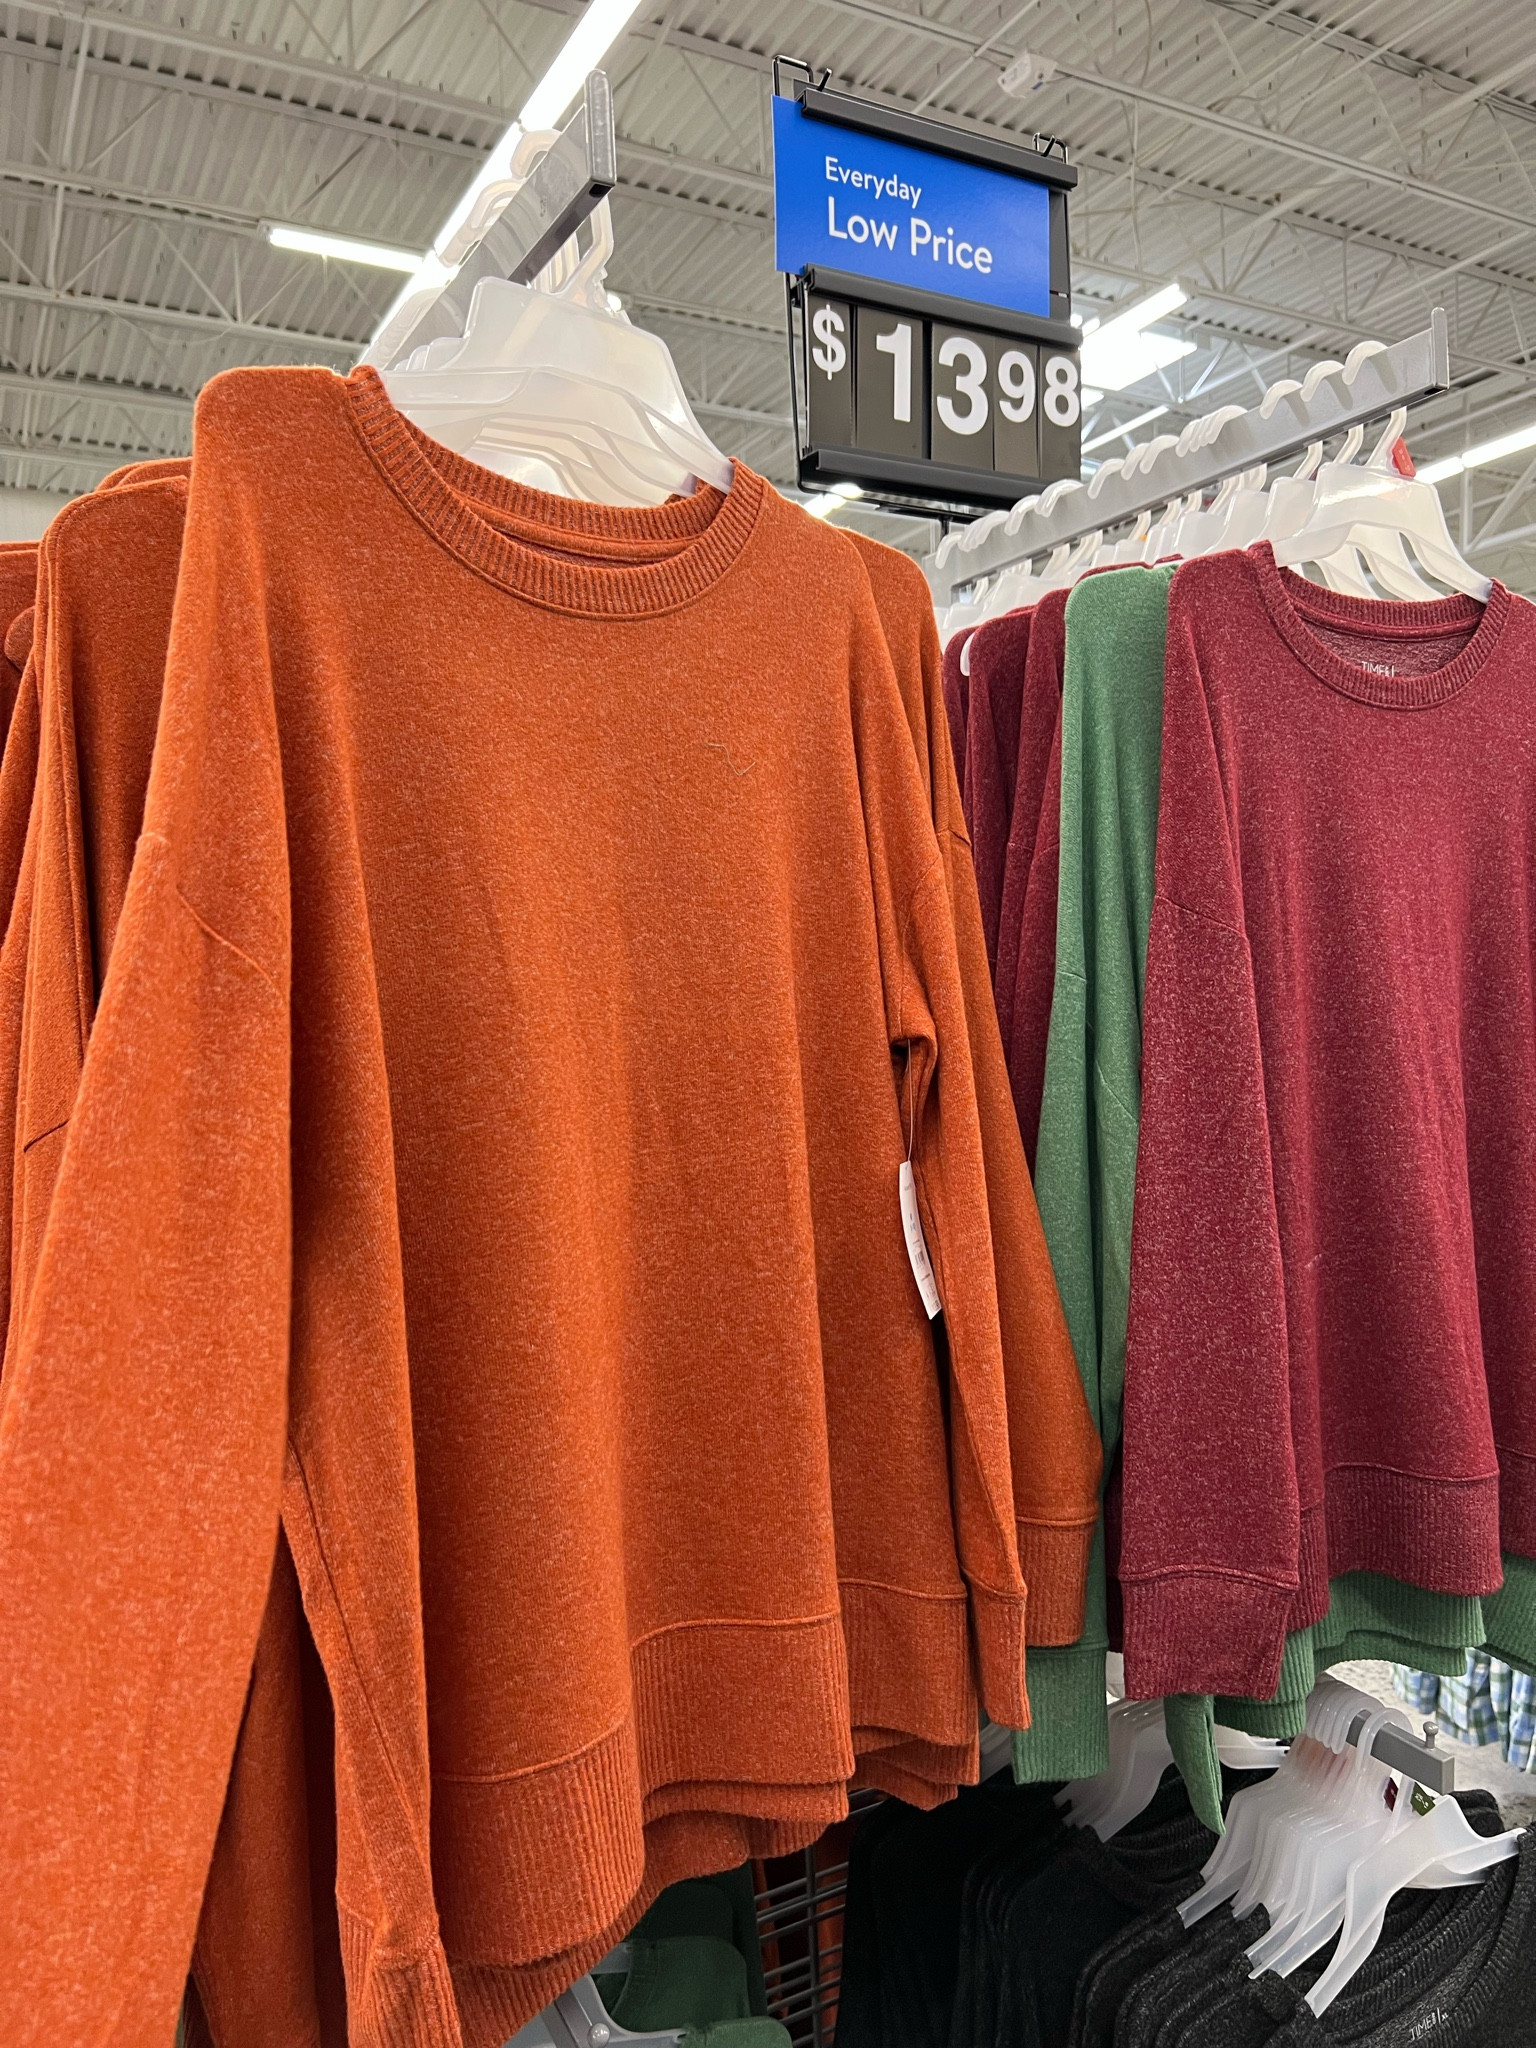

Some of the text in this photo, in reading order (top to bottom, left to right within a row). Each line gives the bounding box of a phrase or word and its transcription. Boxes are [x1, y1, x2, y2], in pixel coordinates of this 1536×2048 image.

[825, 156, 922, 209] Everyday
[828, 196, 993, 274] Low Price
